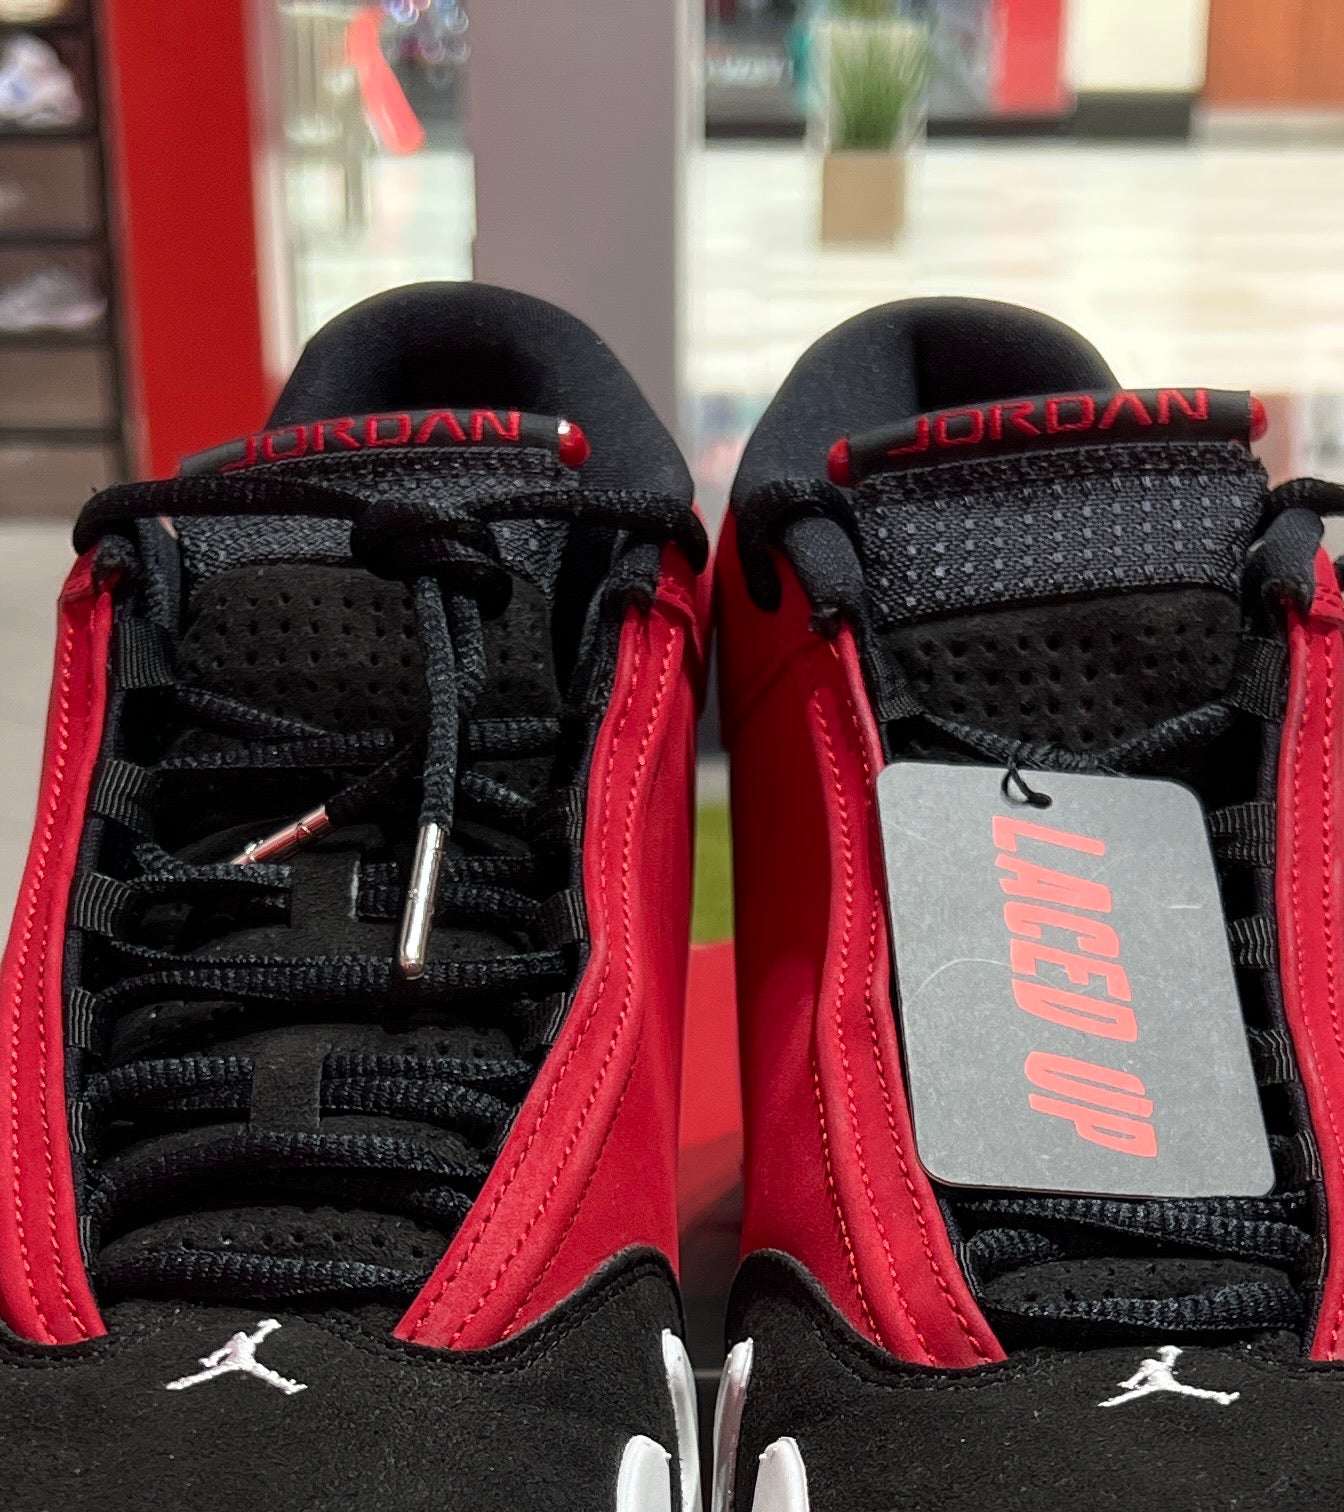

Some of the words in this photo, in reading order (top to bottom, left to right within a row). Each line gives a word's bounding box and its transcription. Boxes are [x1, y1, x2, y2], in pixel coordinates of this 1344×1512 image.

[220, 408, 522, 472] JORDAN
[887, 388, 1209, 455] JORDAN
[991, 814, 1138, 1042] LACED
[1024, 1050, 1157, 1158] UP
